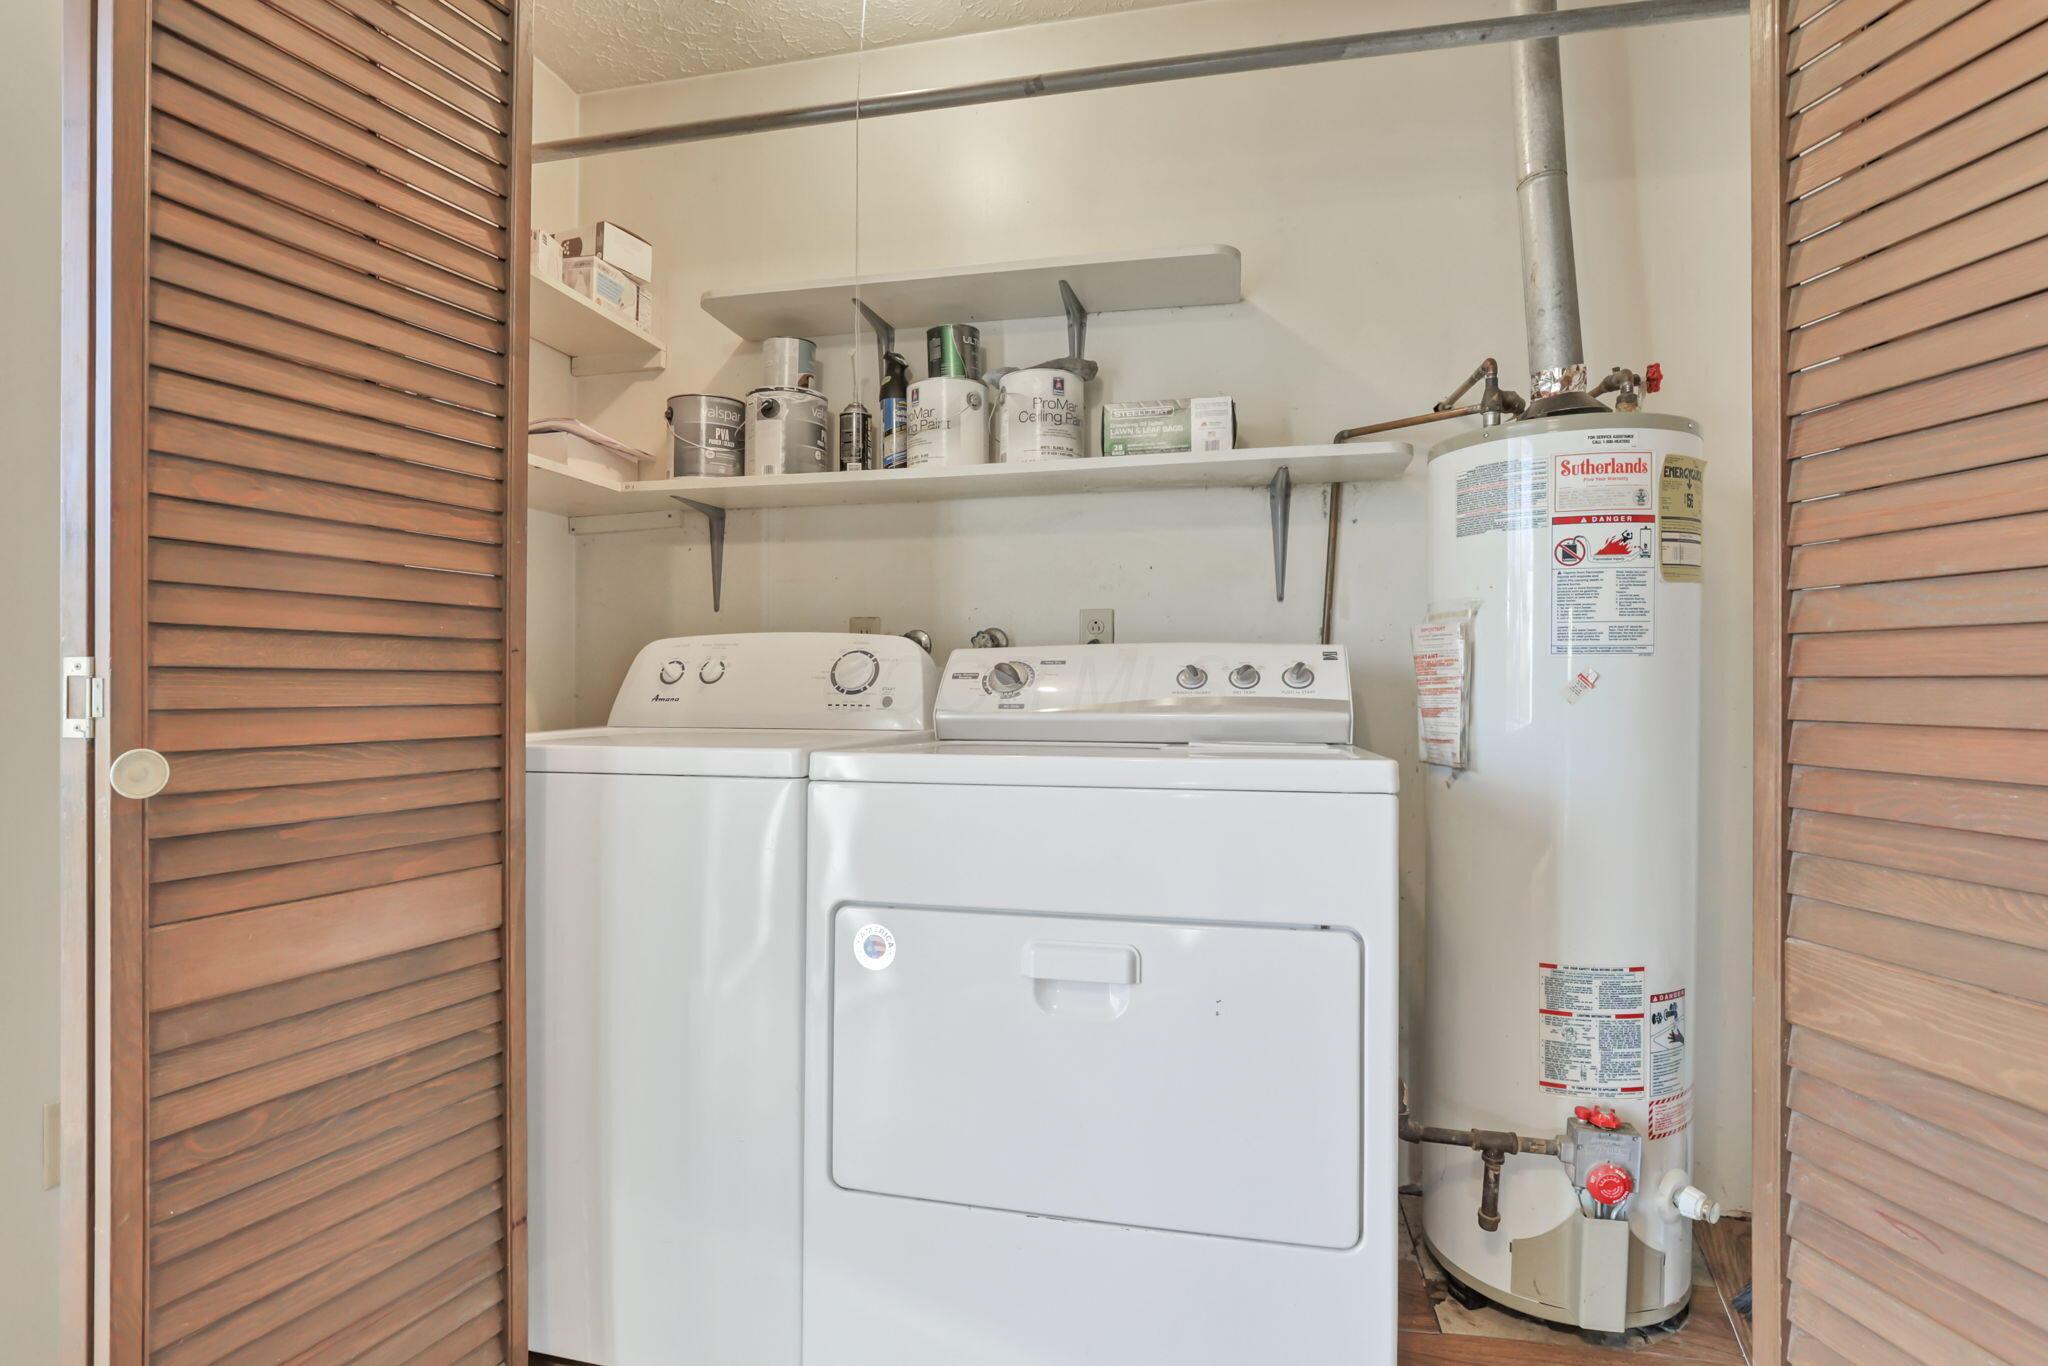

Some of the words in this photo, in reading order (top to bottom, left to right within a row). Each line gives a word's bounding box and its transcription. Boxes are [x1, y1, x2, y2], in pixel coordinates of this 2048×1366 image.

[1032, 397, 1078, 412] ProMar
[1018, 410, 1063, 426] Celing
[715, 427, 730, 441] PVA
[1110, 427, 1134, 436] LAWN
[1142, 425, 1161, 433] LEAF
[1560, 457, 1649, 476] Sutherlands
[651, 693, 680, 702] Amana
